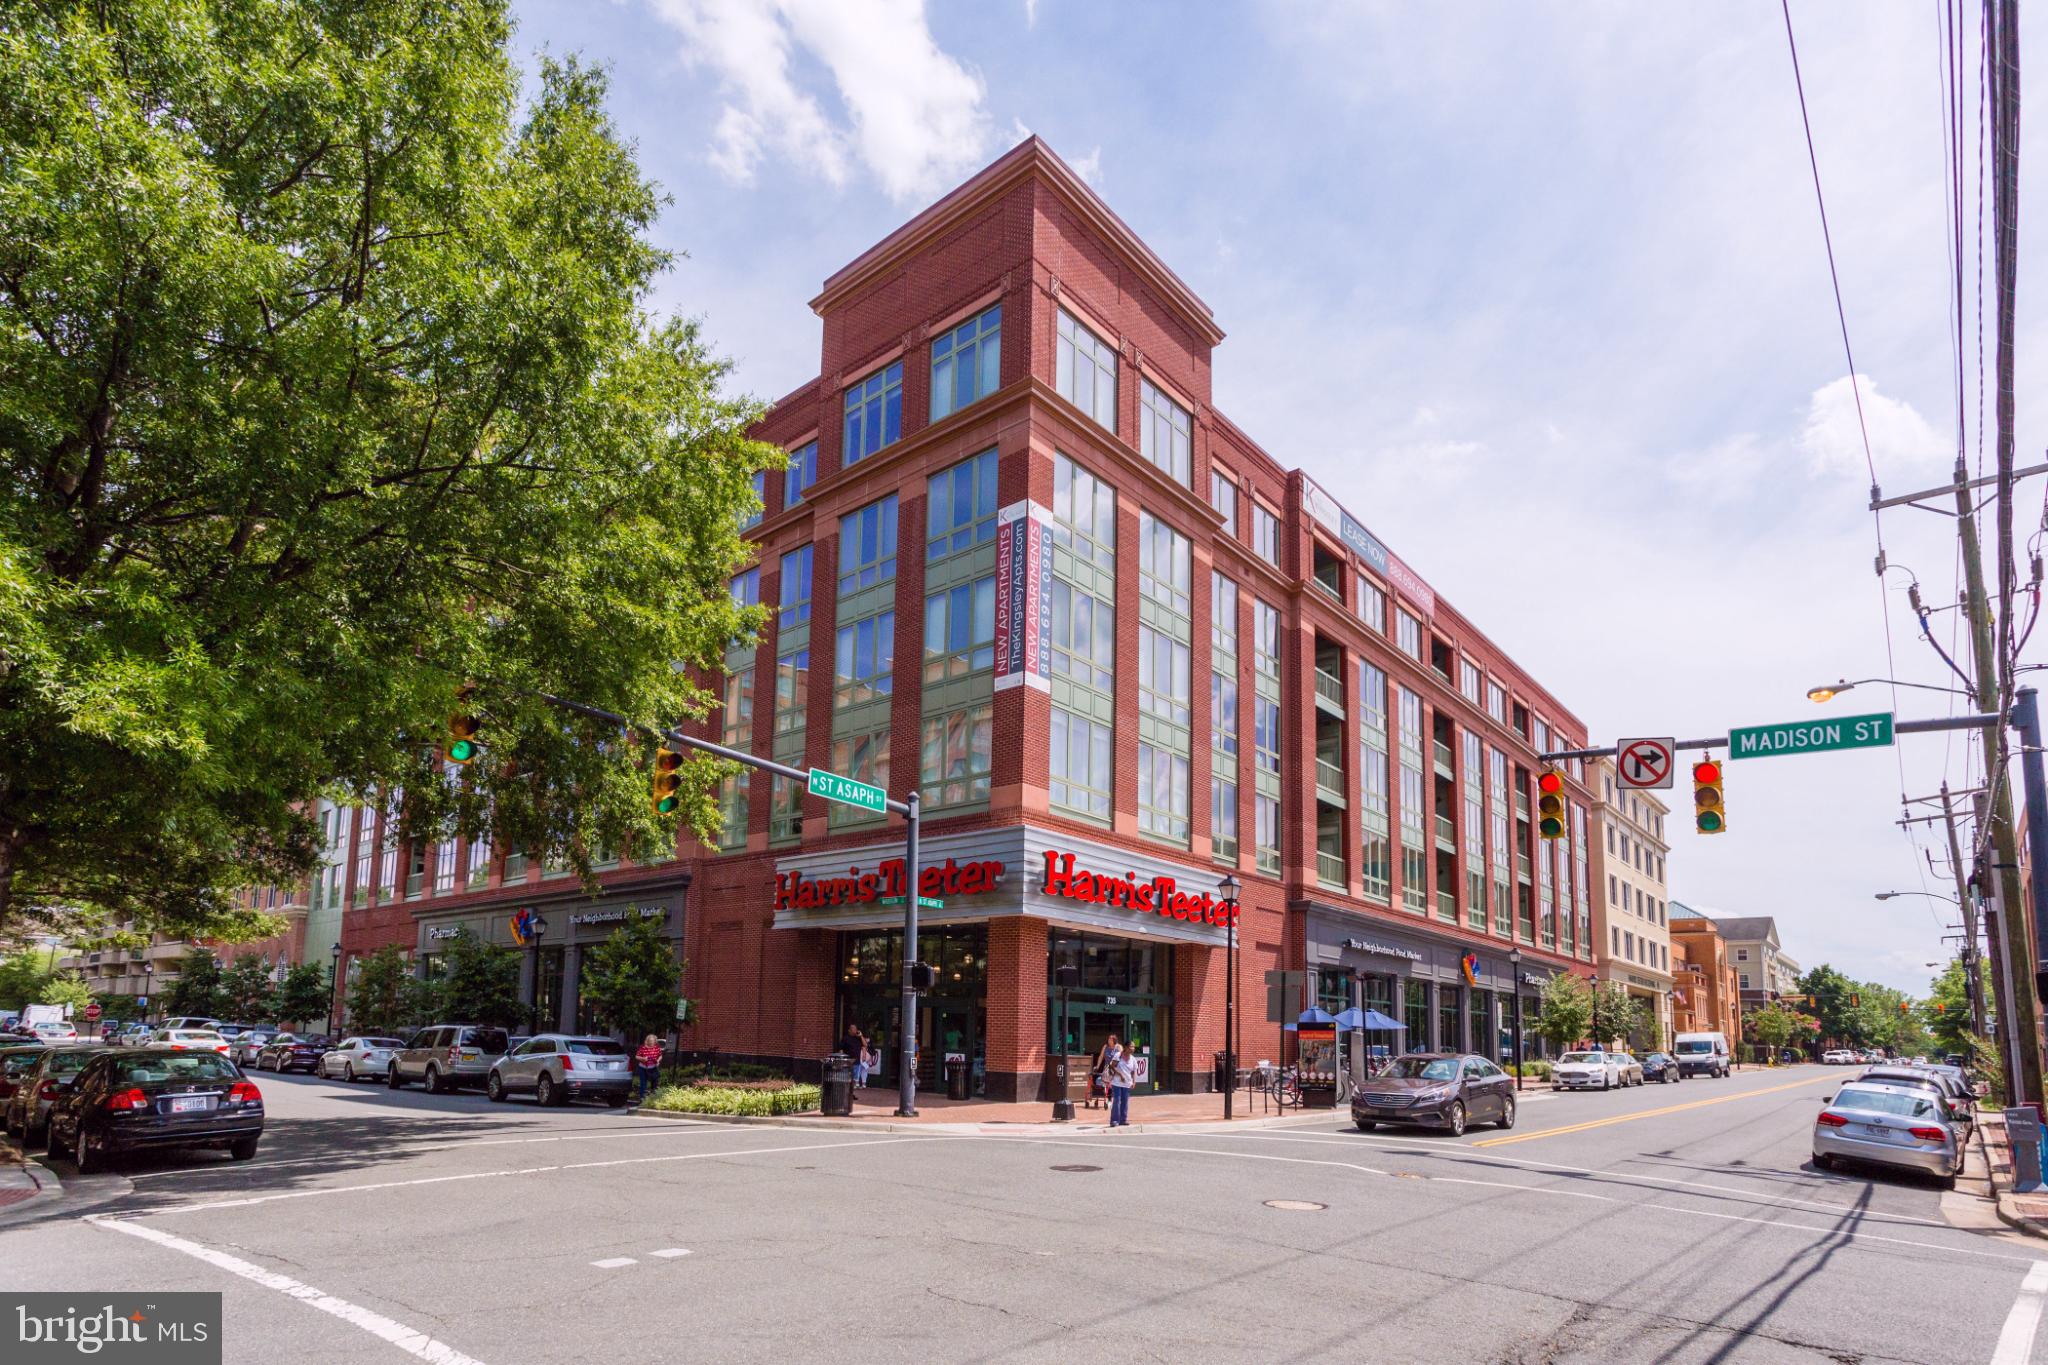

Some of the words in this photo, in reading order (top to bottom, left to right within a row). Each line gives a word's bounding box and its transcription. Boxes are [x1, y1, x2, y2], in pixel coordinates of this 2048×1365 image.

[1343, 521, 1367, 552] LEASE
[1367, 542, 1386, 567] NOW
[999, 528, 1010, 630] APARTMENTS
[1011, 523, 1024, 668] TheKingsleyApts.com
[1028, 523, 1040, 628] APARTMENTS
[1040, 532, 1052, 674] 888.694.0980
[998, 636, 1008, 672] NEW
[1028, 629, 1038, 669] NEW
[1740, 725, 1841, 753] MADISON
[1855, 720, 1883, 741] ST
[819, 776, 834, 793] ST
[836, 781, 874, 805] ASAPH
[775, 867, 877, 910] Harris
[1043, 850, 1154, 912] Harris
